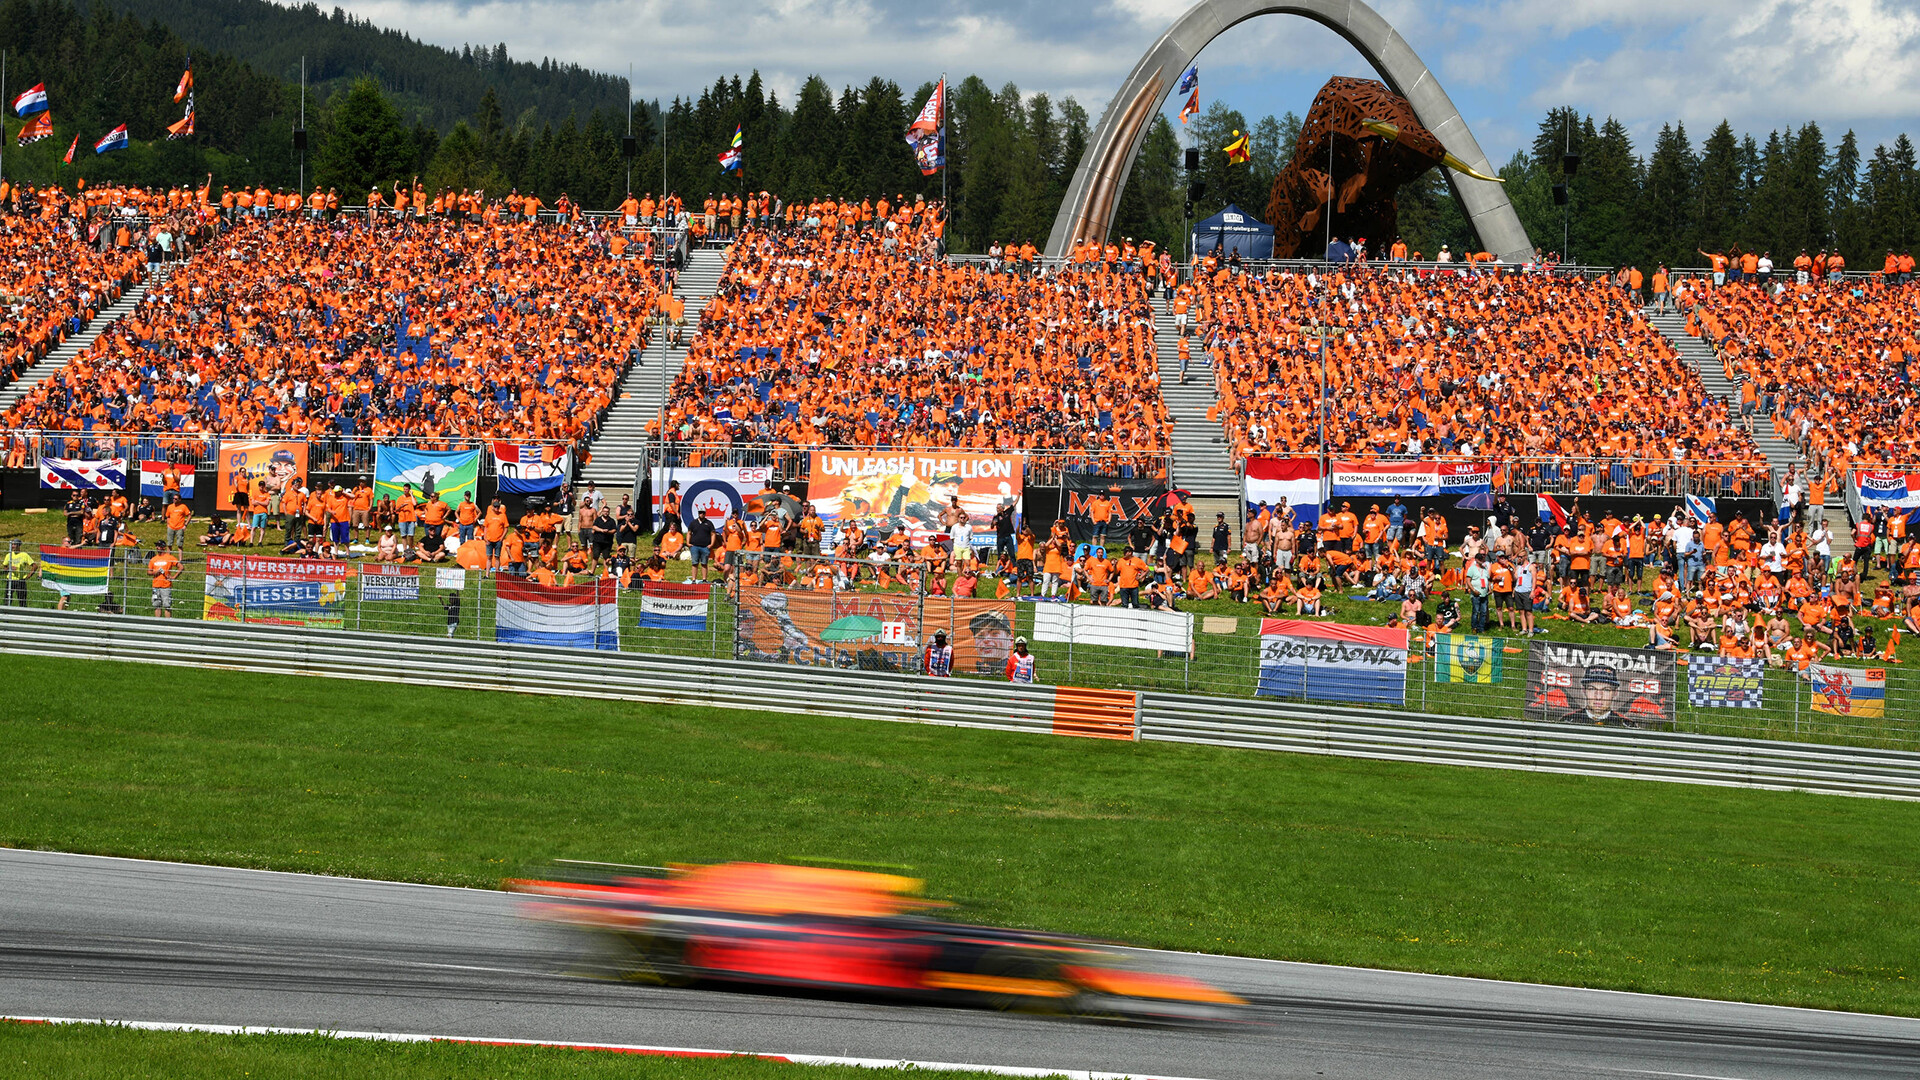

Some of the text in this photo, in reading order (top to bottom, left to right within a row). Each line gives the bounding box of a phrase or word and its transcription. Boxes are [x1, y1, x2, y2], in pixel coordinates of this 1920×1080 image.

[230, 452, 247, 467] GO
[821, 455, 1012, 478] UNLEASH THE LION
[738, 468, 767, 483] 33
[1455, 464, 1474, 474] MAX
[1339, 475, 1385, 483] ROSMALEN
[1441, 474, 1490, 486] VERSTAPPEN
[1067, 490, 1157, 521] MAX
[210, 558, 345, 576] MAX VERSTAPPEN
[382, 565, 401, 575] MAX
[365, 576, 417, 587] VERSTAPPEN
[652, 602, 694, 611] HOLLAND
[831, 597, 918, 629] MAX
[1541, 669, 1573, 688] 33
[1868, 671, 1885, 680] 33
[1629, 678, 1661, 695] 33
